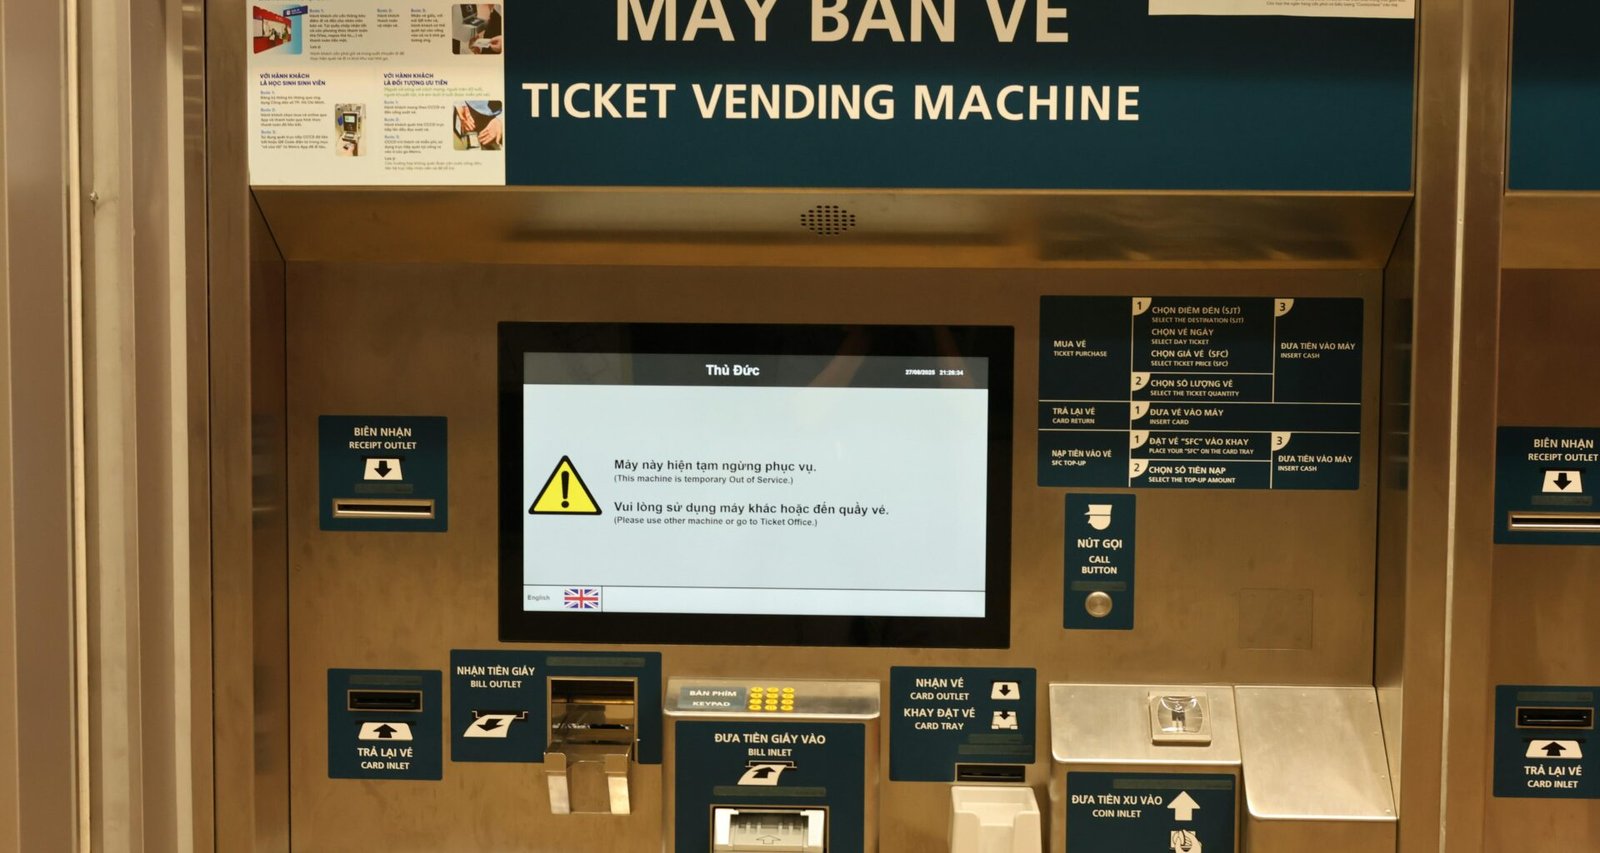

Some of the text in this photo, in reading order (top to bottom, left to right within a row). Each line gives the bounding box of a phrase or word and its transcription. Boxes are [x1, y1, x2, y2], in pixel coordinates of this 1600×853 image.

[523, 83, 1139, 121] TICKET VENDING MACHINE
[1137, 301, 1142, 310] 1
[1280, 302, 1286, 312] 3
[706, 364, 760, 376] Thủ Đức
[1136, 376, 1141, 385] 2
[1136, 406, 1139, 414] 1
[1171, 408, 1181, 416] VÉ
[1184, 408, 1202, 416] VÀO
[354, 426, 377, 436] BIÊN
[1135, 435, 1139, 443] 1
[1277, 436, 1282, 445] 3
[1534, 437, 1558, 448] BIÊN
[384, 442, 416, 450] OUTLET
[1564, 453, 1598, 462] OUTLET
[615, 459, 816, 474] Máy này hiện tạm ngừng phục vụ.
[1134, 463, 1140, 472] 2
[614, 474, 635, 482] (This
[684, 476, 726, 484] temporary
[757, 476, 793, 485] Service.)
[614, 501, 888, 516] Vui lòng sử dụng máy khác hoặc đến quầy vé.
[614, 516, 644, 525] (Please
[787, 518, 817, 527] Office.)
[1078, 537, 1122, 550] NÚT GỌI
[1089, 556, 1110, 564] CALL
[950, 677, 964, 688] VÉ
[904, 708, 934, 717] KHAY
[962, 707, 975, 718] VÉ
[714, 733, 740, 743] ĐƯA
[801, 733, 826, 744] VÀO
[400, 747, 413, 758] VÉ
[748, 748, 792, 756] BILL INLET
[1568, 765, 1582, 776] VÉ
[1072, 794, 1095, 804] ĐƯA
[1123, 796, 1137, 805] XU
[1140, 794, 1162, 805] VÀO
